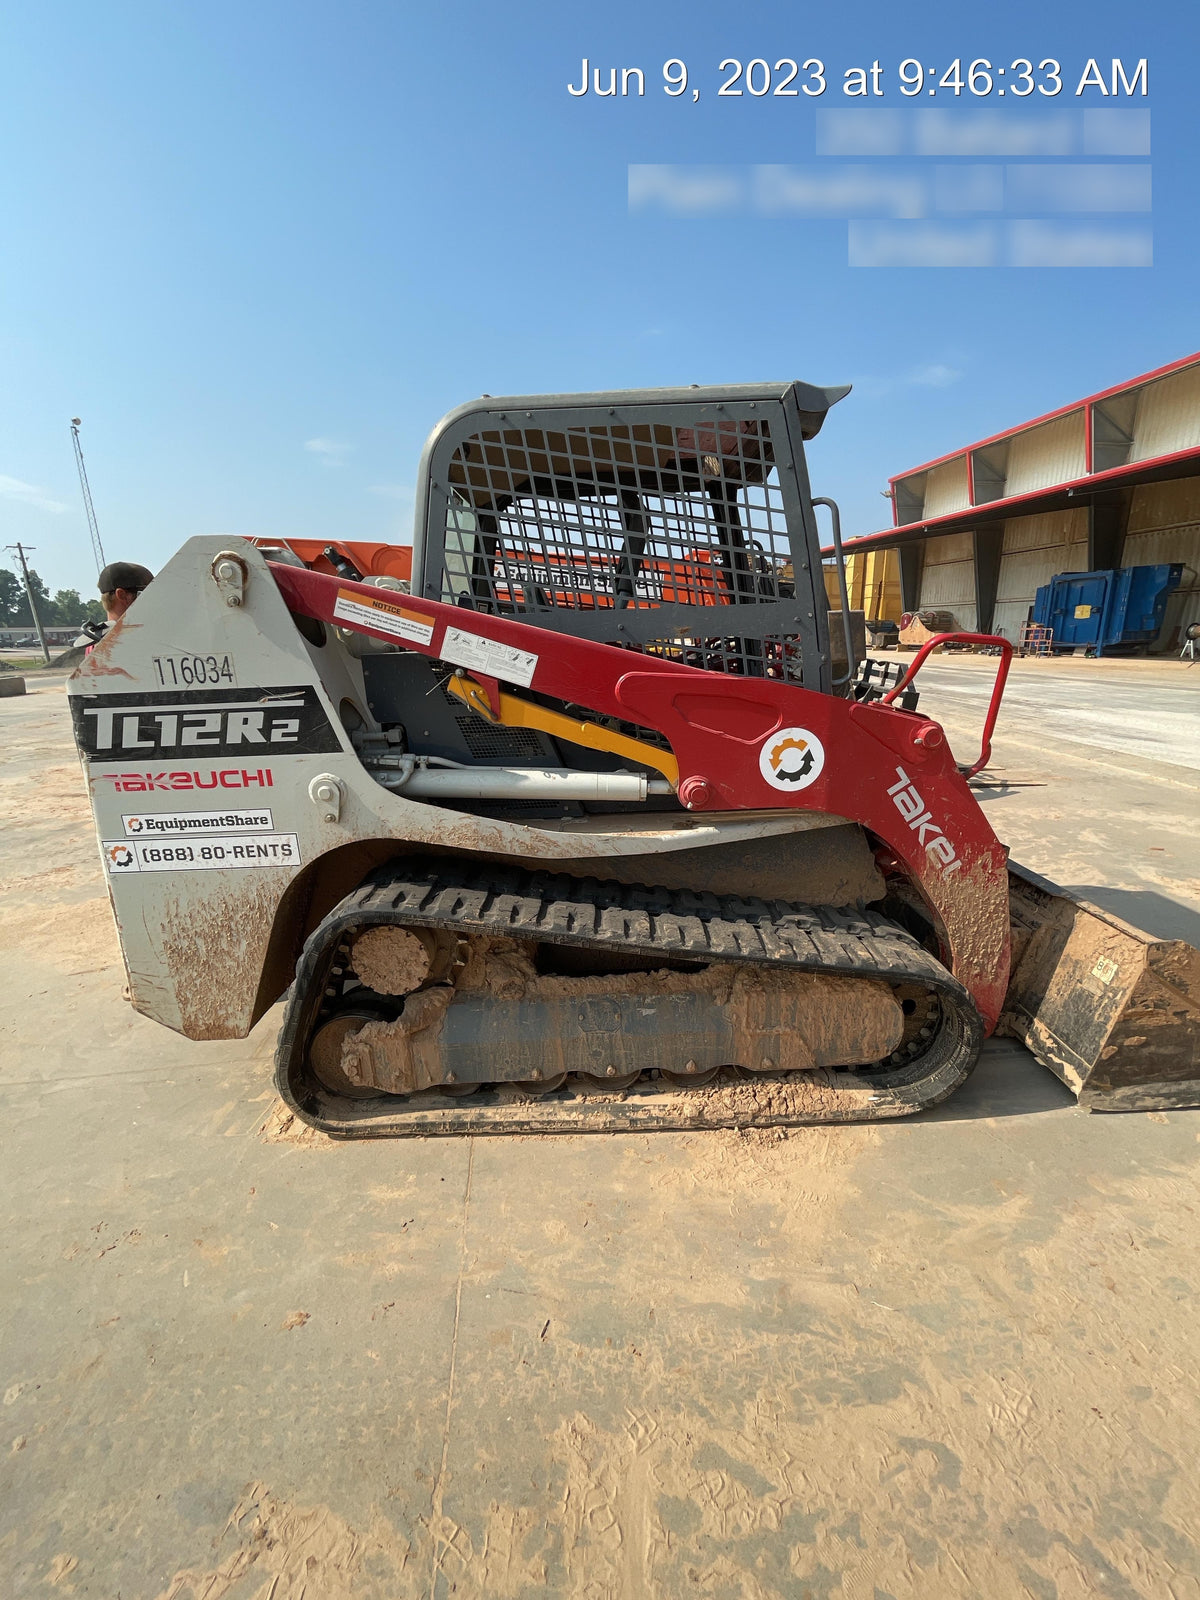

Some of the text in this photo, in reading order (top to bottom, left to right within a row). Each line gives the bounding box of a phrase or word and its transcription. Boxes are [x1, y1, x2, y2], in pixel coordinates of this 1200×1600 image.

[372, 600, 401, 615] NOTICE
[153, 655, 234, 686] 116034
[84, 699, 304, 750] TL12R2
[145, 814, 269, 831] EquipmentShare
[142, 843, 293, 863] (888) 80-RENTS
